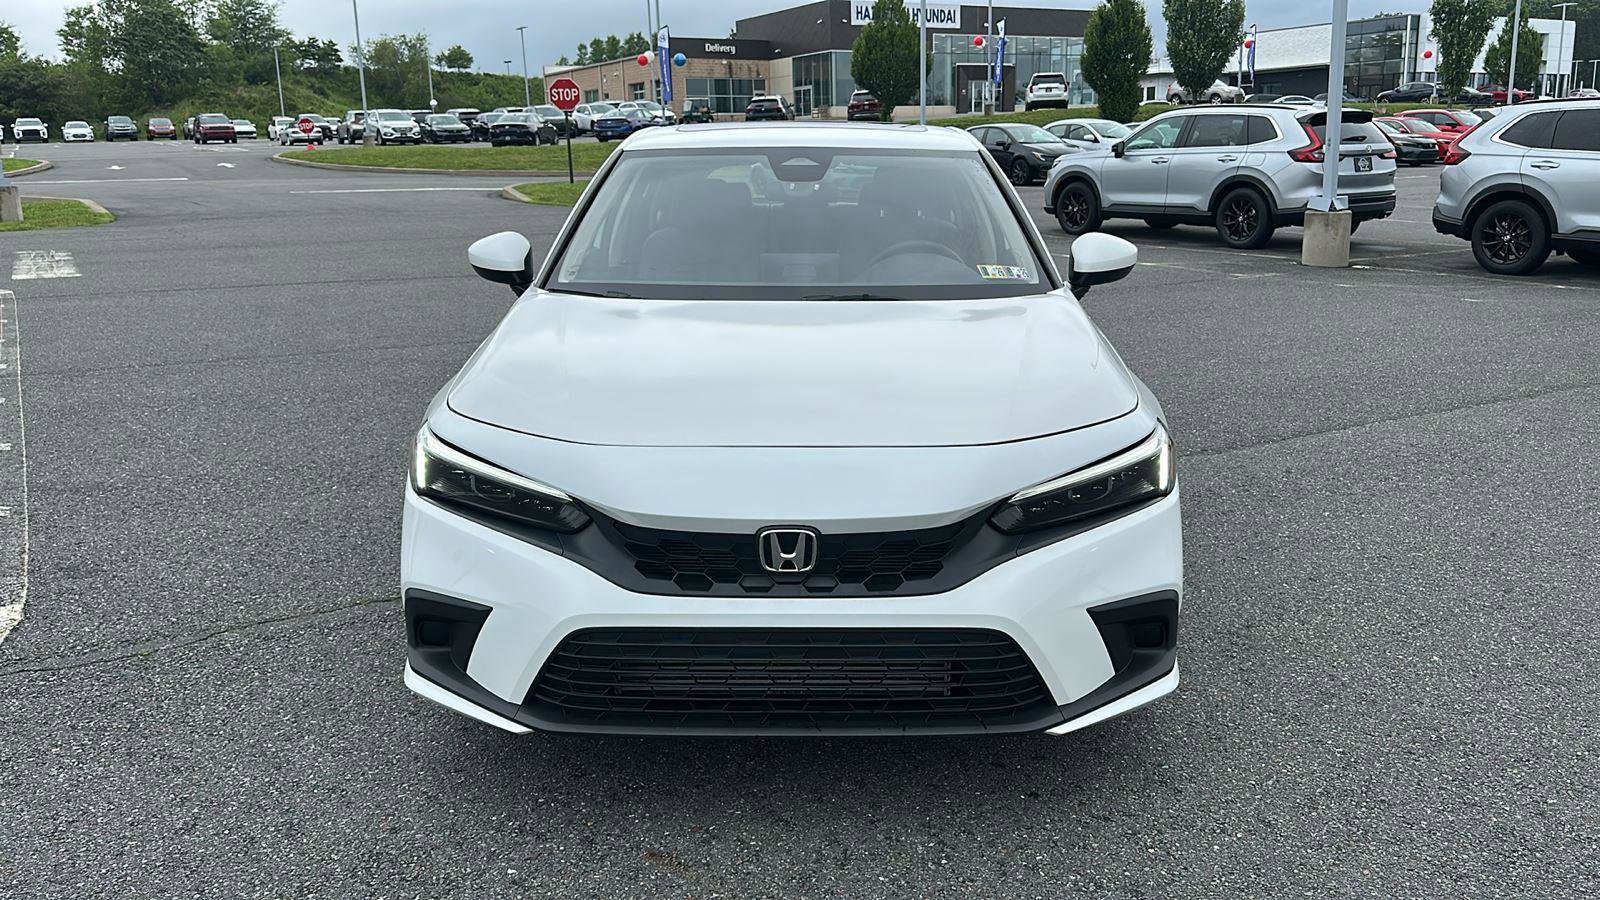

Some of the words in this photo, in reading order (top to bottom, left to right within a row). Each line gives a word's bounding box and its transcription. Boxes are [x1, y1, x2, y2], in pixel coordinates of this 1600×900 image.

[705, 43, 736, 55] Delivery
[551, 88, 579, 101] STOP
[299, 122, 313, 130] STOP
